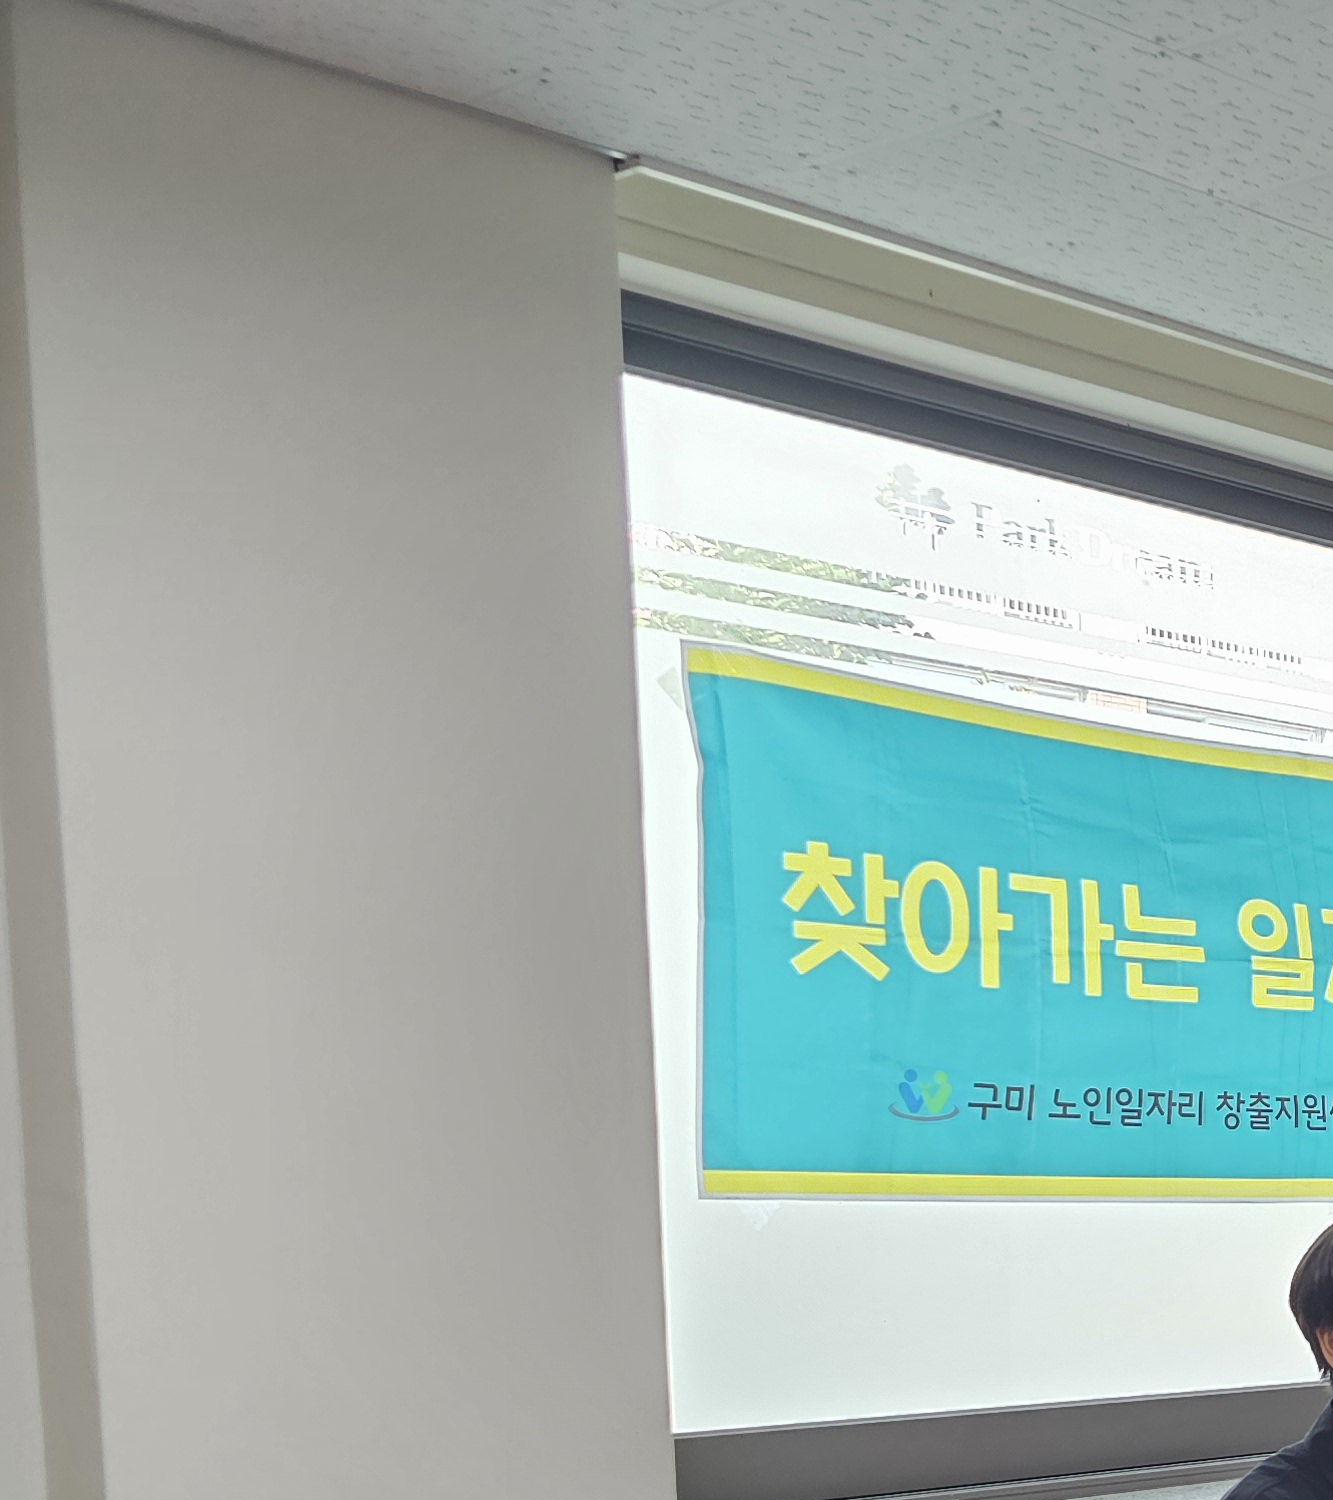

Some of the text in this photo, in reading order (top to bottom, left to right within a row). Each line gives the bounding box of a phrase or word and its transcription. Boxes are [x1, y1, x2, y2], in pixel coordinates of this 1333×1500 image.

[782, 839, 1207, 1005] 찾아가는
[966, 1081, 1037, 1123] 구미
[1047, 1086, 1205, 1128] 노인일자리
